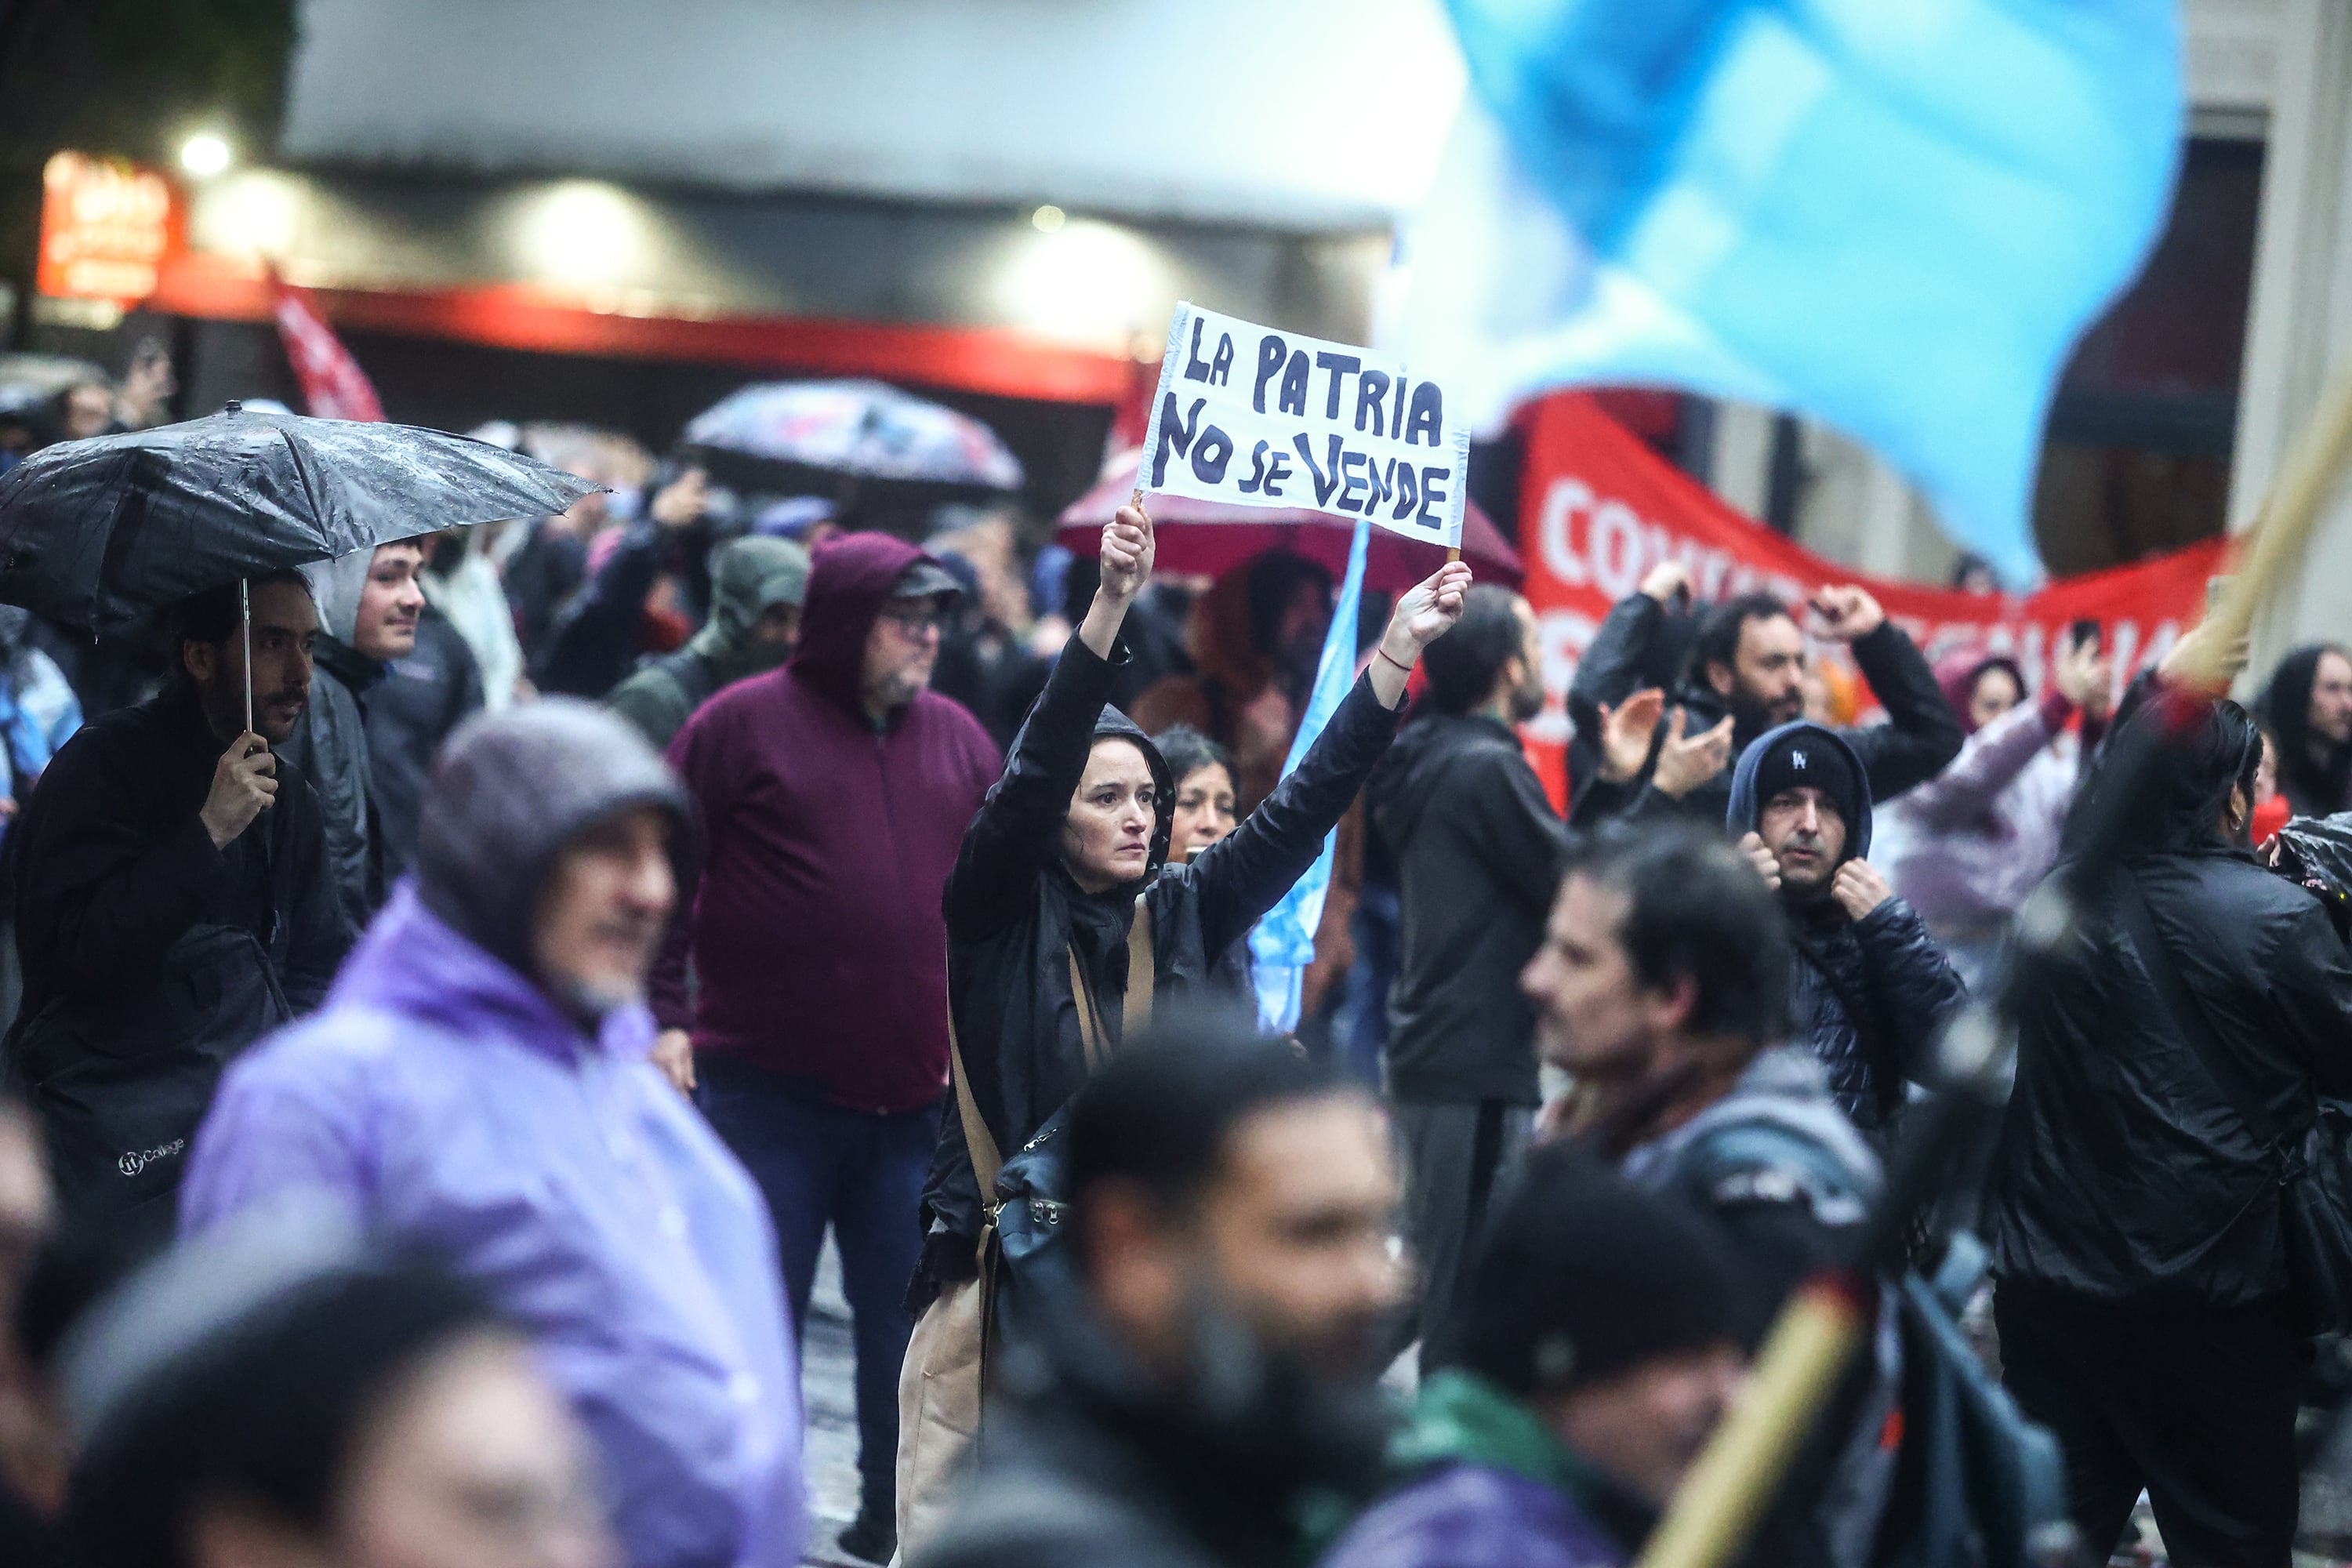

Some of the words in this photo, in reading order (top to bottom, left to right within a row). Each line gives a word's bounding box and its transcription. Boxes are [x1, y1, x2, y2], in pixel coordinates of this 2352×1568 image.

[1184, 317, 1234, 387] LA
[1151, 392, 1233, 488] NO
[1238, 439, 1293, 496] SE
[1292, 432, 1450, 530] VENDE
